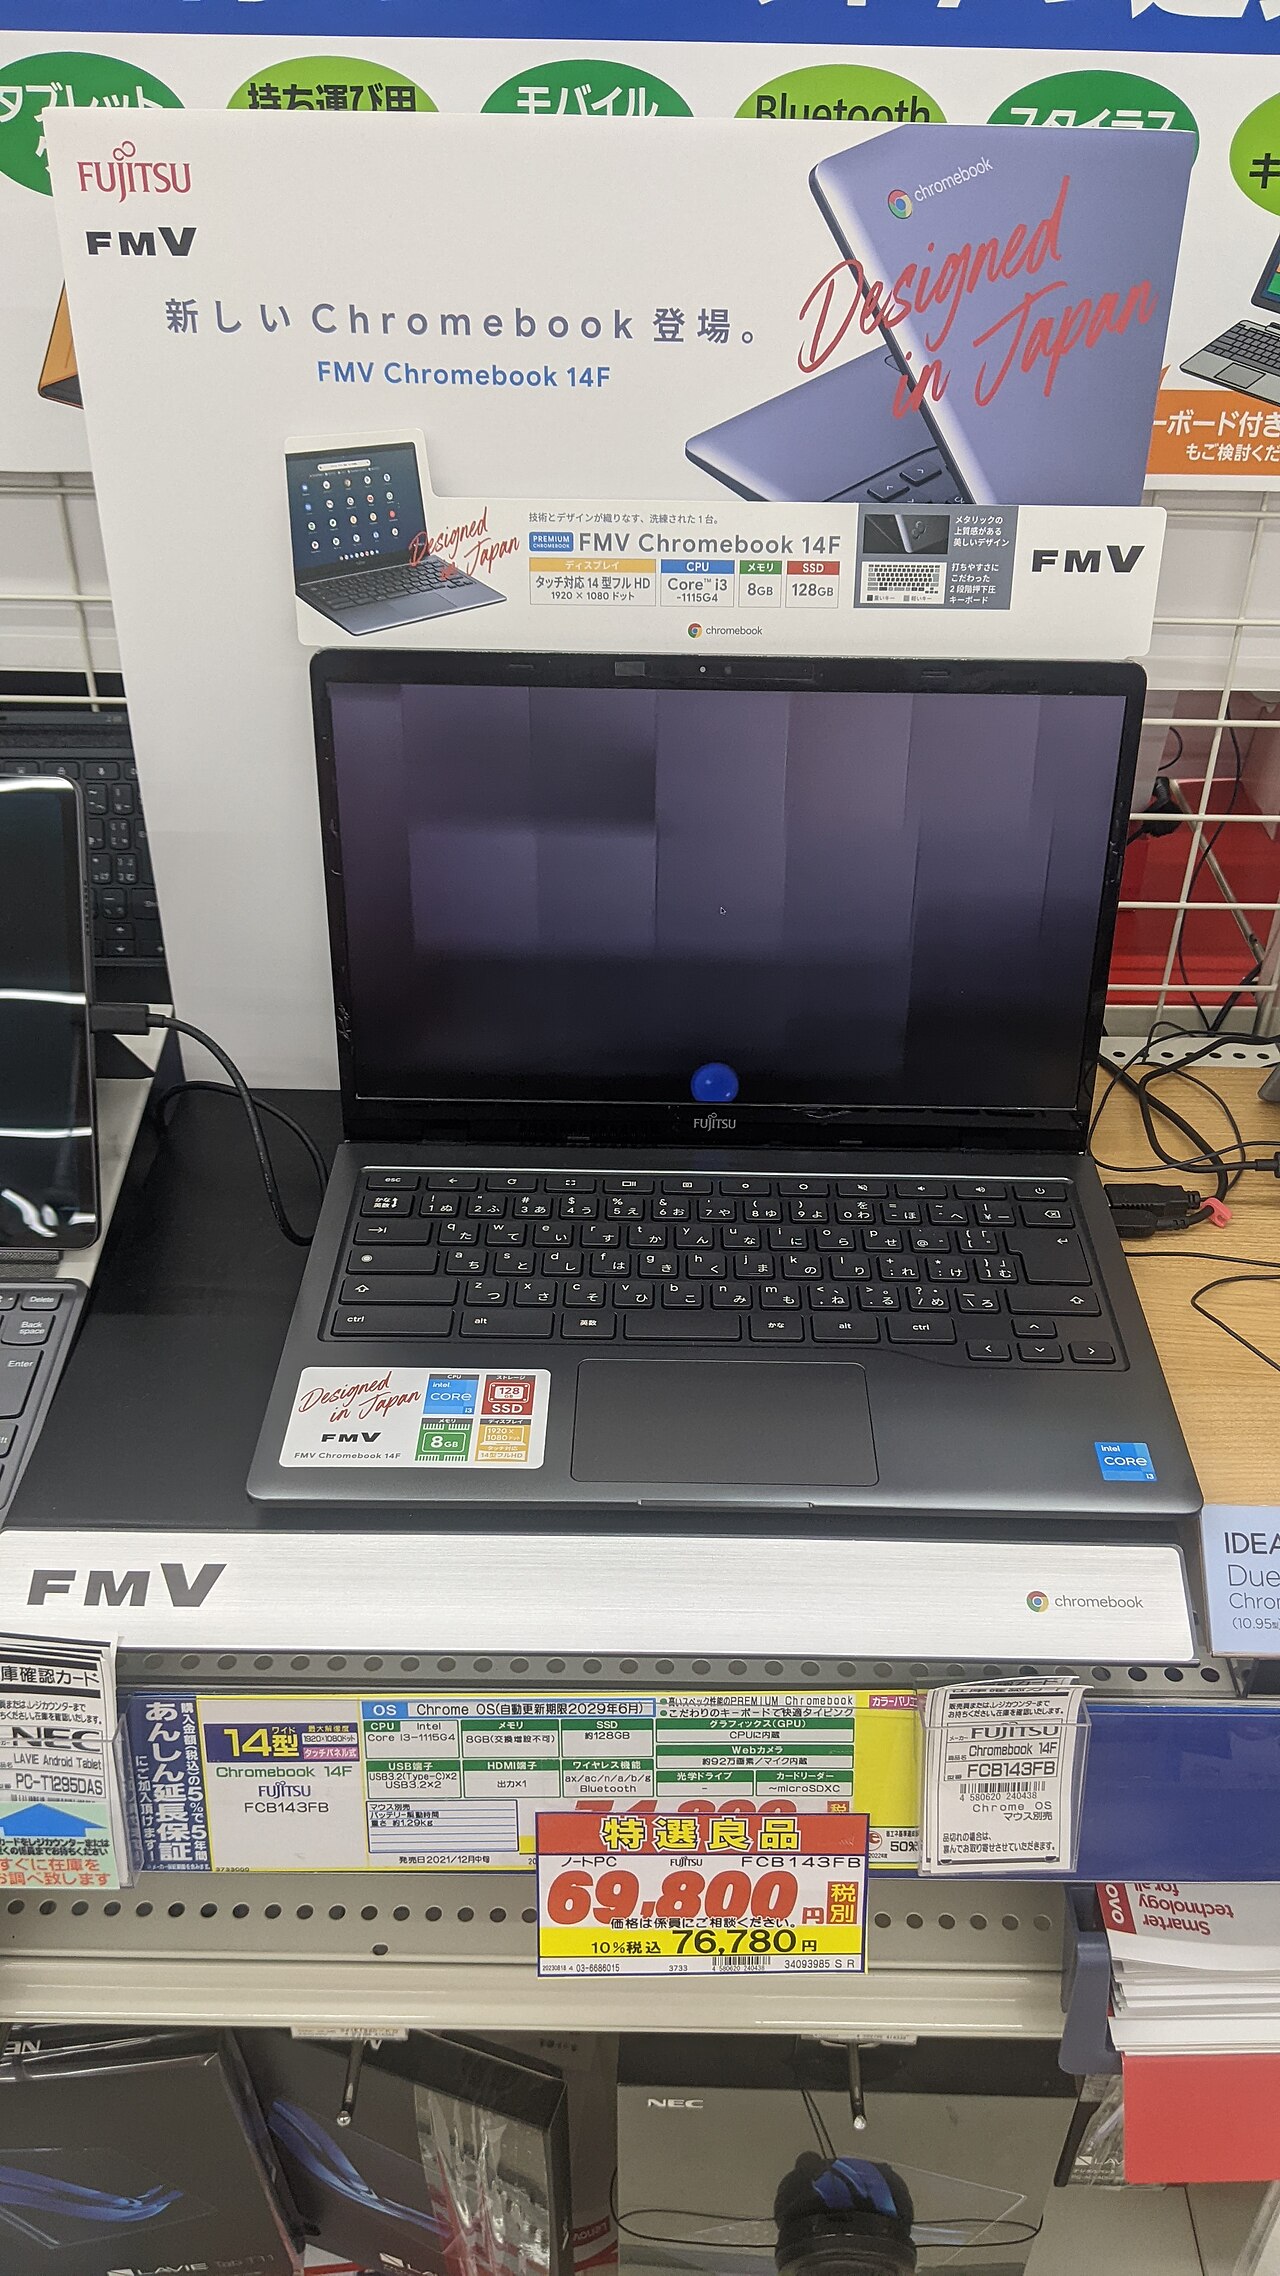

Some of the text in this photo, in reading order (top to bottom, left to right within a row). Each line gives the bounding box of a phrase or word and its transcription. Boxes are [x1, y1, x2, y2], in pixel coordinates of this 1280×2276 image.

[247, 82, 416, 111] 持ち運び用
[517, 86, 657, 117] モバイル
[77, 141, 191, 203] FUJITSU
[914, 157, 993, 202] chromebook
[86, 227, 197, 256] FMV
[798, 175, 1070, 374] Designed
[973, 280, 1158, 406] Japan
[318, 361, 611, 388] FMV Chromebook 14F
[893, 351, 949, 418] in
[955, 515, 1003, 525] メタリックの
[408, 506, 488, 567] Designed
[533, 535, 570, 543] PREMIUM
[953, 538, 1009, 547] 美しいデザイン
[579, 533, 841, 554] FMV Chromebook 14F
[464, 536, 520, 576] Japan
[1031, 545, 1145, 573] FMV
[565, 561, 620, 571] ディスプレイ
[686, 562, 709, 572] CPU
[747, 563, 773, 572] メモリ
[802, 563, 824, 573] SSD
[951, 563, 999, 572] 打ちやすさに
[951, 574, 990, 582] こだわった
[715, 578, 728, 591] i3
[747, 583, 773, 597] 8GB
[791, 584, 834, 597] 128GB
[551, 591, 573, 600] 1920
[587, 592, 609, 600] 1080
[676, 592, 718, 603] -1115G4
[949, 596, 988, 604] キーボード
[706, 626, 762, 636] chromebook
[693, 1112, 736, 1131] FUJITSU
[347, 1315, 364, 1323] ctrl
[912, 1323, 930, 1331] ctrl
[299, 1371, 392, 1412] Designed
[358, 1391, 421, 1419] Japan
[492, 1404, 523, 1413] SSD
[329, 1409, 351, 1423] in
[321, 1432, 381, 1442] FMV
[431, 1436, 458, 1448] 8GB
[27, 1563, 227, 1607] FMV
[1054, 1595, 1144, 1609] chromebook
[1, 1665, 100, 1687] 庫確認カード
[785, 1696, 853, 1706] Chromebook
[373, 1705, 397, 1716] OS
[416, 1703, 469, 1716] Chrome
[272, 1726, 296, 1734] ワイド
[370, 1722, 394, 1730] CPU
[417, 1722, 441, 1730] Intel
[499, 1721, 523, 1730] メモリ
[596, 1720, 618, 1729] SSD
[971, 1721, 1059, 1740] FUJITSU
[12, 1726, 100, 1752] NEC
[367, 1733, 394, 1742] Core
[584, 1732, 630, 1740] 約128GB
[729, 1731, 780, 1739] CPUに内蔵
[304, 1747, 357, 1758] タッチパネル式
[732, 1746, 783, 1755] Webカメラ
[968, 1742, 1058, 1757] Chromebook 14F
[14, 1753, 102, 1770] LAVIE Android Tablet
[487, 1761, 537, 1770] HDMI端子
[573, 1761, 641, 1770] ワイヤレス機能
[216, 1766, 352, 1777] Chromebook 14F
[777, 1771, 834, 1780] カードリーダー
[967, 1761, 1056, 1778] FCB143FB
[145, 1701, 193, 1862] あんしん延長保証
[565, 1774, 651, 1783] ax/ac/n/a/b/g
[676, 1771, 733, 1781] 光学ドライブ
[15, 1772, 103, 1796] PC-T1295DAS
[258, 1780, 311, 1799] FUJITSU
[580, 1785, 637, 1793] Bluetooth
[970, 1792, 1037, 1801] 580620 240438
[244, 1802, 329, 1813] FCB143FB
[370, 1803, 411, 1811] マウス別売
[972, 1801, 1052, 1813] Chrome OS
[1003, 1812, 1053, 1822] マウス別売
[600, 1816, 800, 1852] 特選良品
[562, 1856, 617, 1867] ノートPC
[670, 1856, 703, 1868] FUJITSU
[741, 1856, 860, 1868] FCB143FB
[547, 1869, 824, 1926] 69,800 円
[830, 1883, 856, 1923] 税別
[1139, 1893, 1234, 1918] technology
[610, 1916, 796, 1930] 価格は係員にご相談ください。
[1143, 1914, 1211, 1936] Smarter
[672, 1929, 796, 1956] 76,780
[802, 1940, 817, 1952] 円
[784, 1959, 830, 1969] 34093985
[648, 2098, 704, 2109] NEC
[137, 2262, 209, 2275] LAVIE
